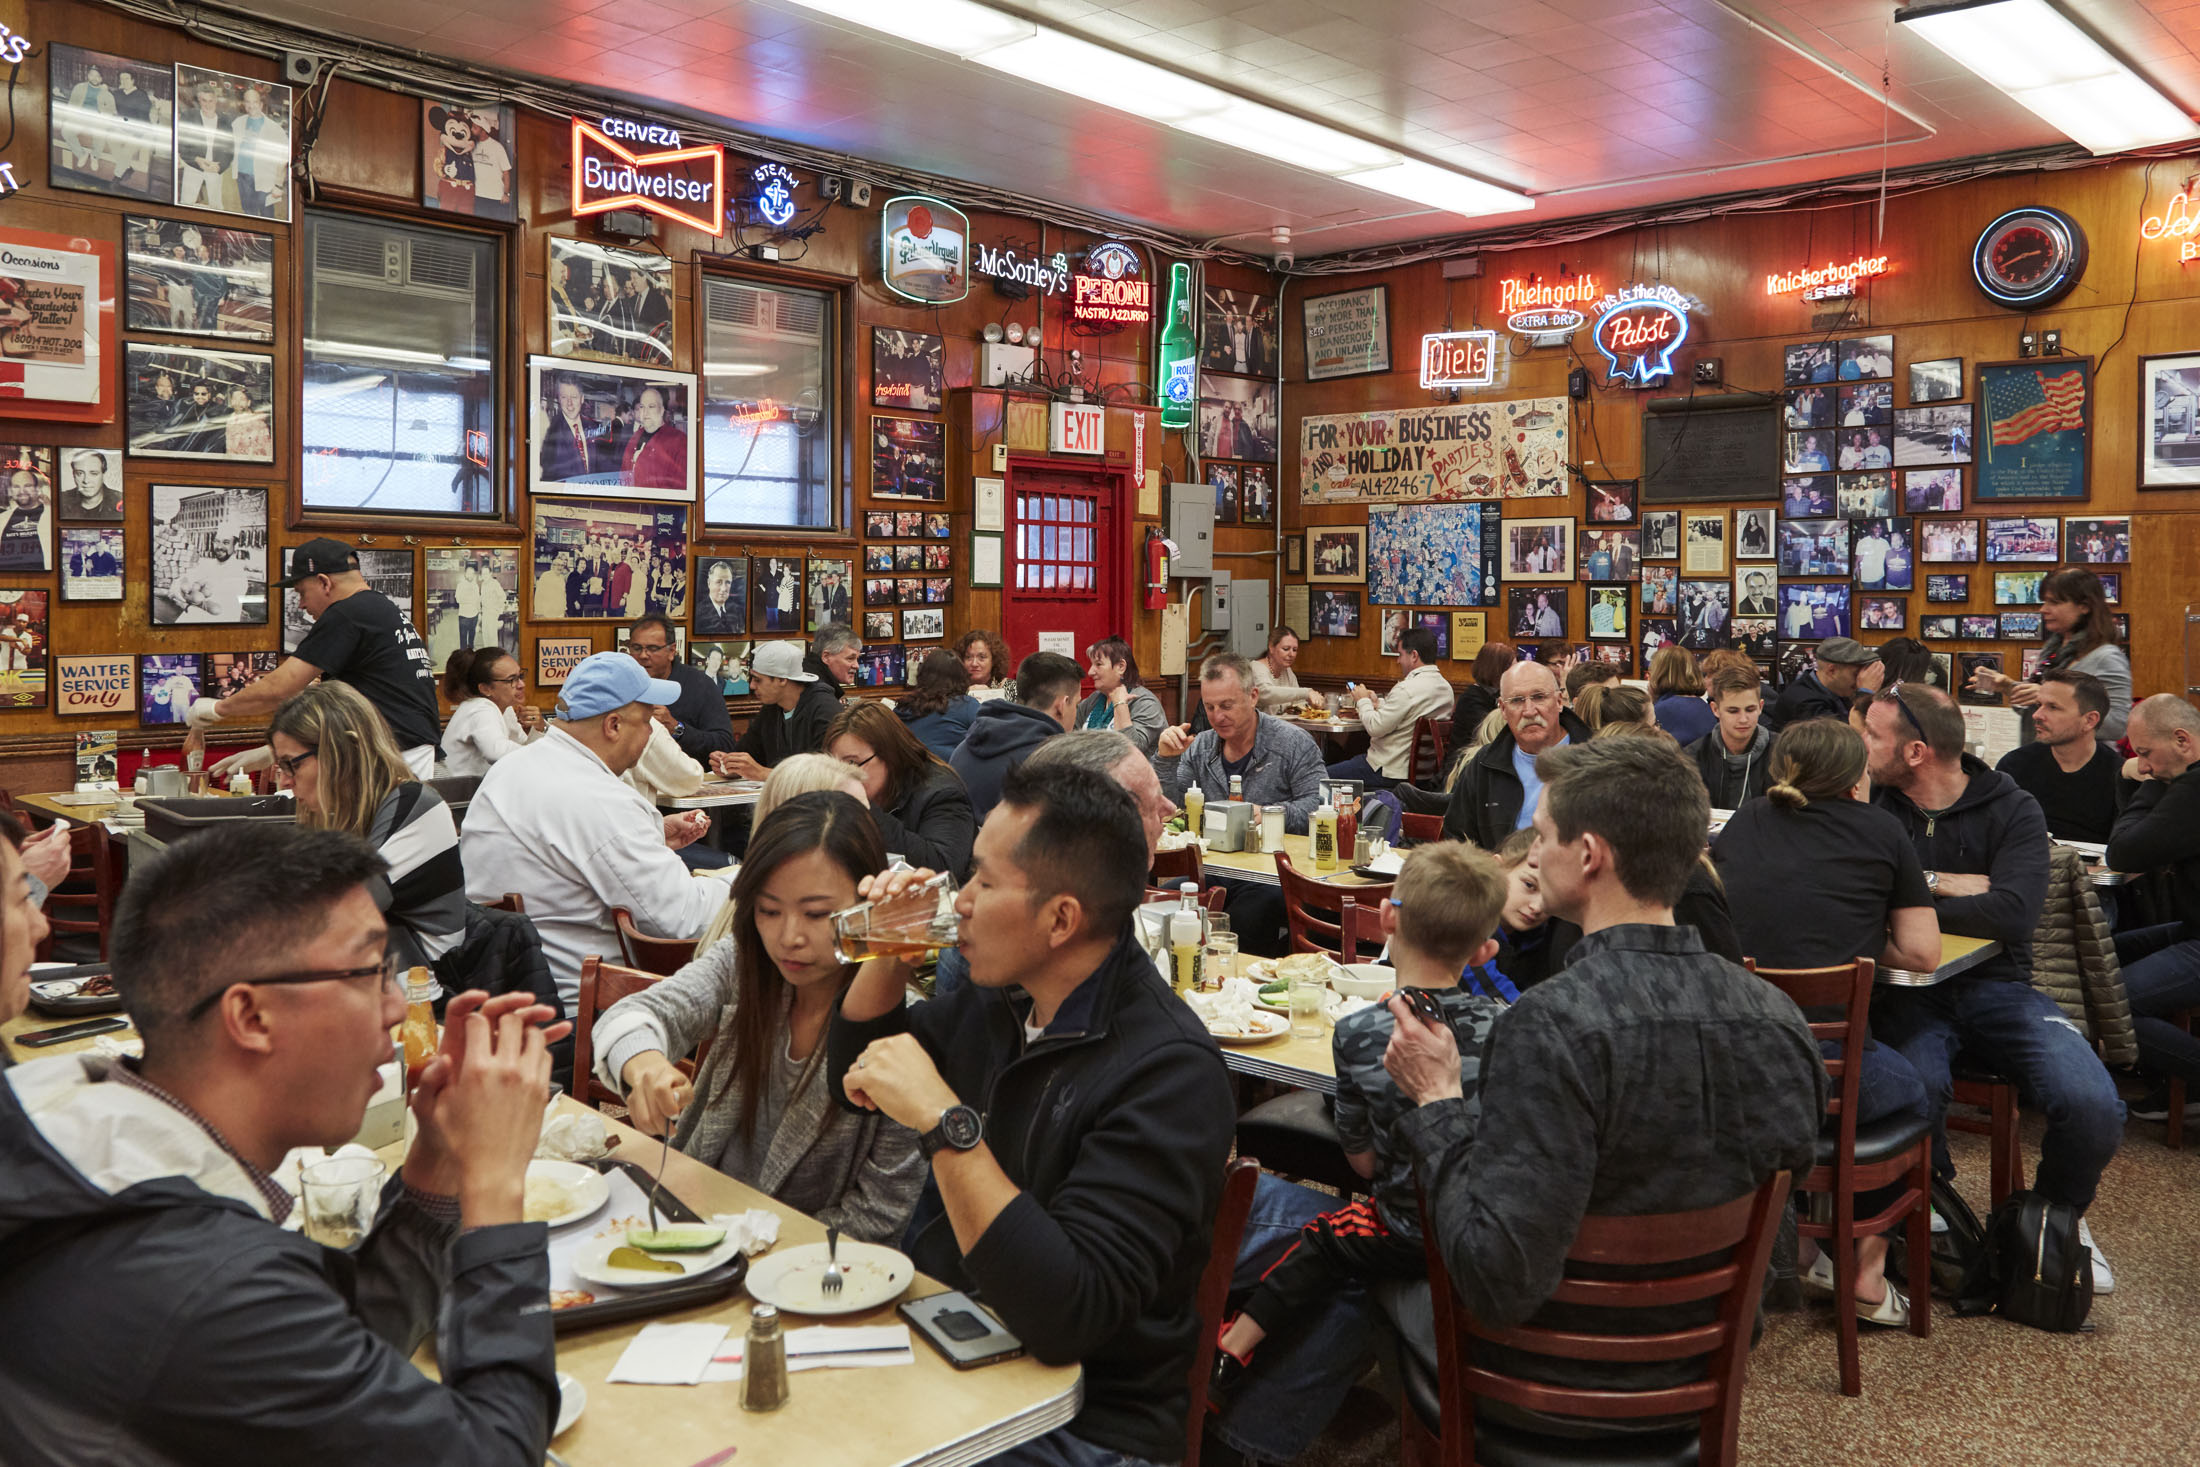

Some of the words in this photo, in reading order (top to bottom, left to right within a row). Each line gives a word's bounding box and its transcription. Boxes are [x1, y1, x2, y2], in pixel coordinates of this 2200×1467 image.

[602, 117, 682, 150] CERVEZA
[584, 157, 713, 202] Budweiser
[754, 163, 800, 189] STEAM
[1, 251, 60, 270] Occasions
[978, 244, 1068, 296] McSorley's
[1767, 256, 1888, 296] Knickerbocker
[17, 287, 52, 300] Order
[53, 287, 83, 300] Your
[1075, 275, 1150, 307] PERONI
[1499, 274, 1595, 314] Rheingold
[25, 299, 78, 313] Sandwich
[1318, 294, 1371, 313] OCCUPANCY
[30, 311, 73, 325] Platter!
[1075, 305, 1110, 321] NASTRO
[1110, 308, 1149, 322] AZZURRO
[1315, 314, 1327, 326] BY
[1329, 309, 1353, 323] MORE
[1356, 306, 1378, 318] THAN
[1516, 315, 1548, 327] EXTRA
[1553, 314, 1576, 326] DRY
[1309, 327, 1325, 337] 340
[1328, 319, 1368, 335] PERSONS
[1609, 312, 1673, 350] Pabst
[1319, 331, 1373, 348] DANGEROUS
[1314, 349, 1333, 360] AND
[1335, 341, 1381, 357] UNLAWFUL
[1008, 406, 1044, 446] EXIT
[1064, 410, 1101, 451] EXIT
[1309, 424, 1339, 450] FOR
[1346, 419, 1387, 447] YOUR
[1311, 452, 1334, 480] AND
[1347, 446, 1427, 475] HOLIDAY
[541, 645, 588, 656] WAITER
[61, 664, 131, 679] WAITER
[545, 667, 573, 679] Onl
[62, 678, 131, 693] SERVICE
[68, 690, 121, 708] Only
